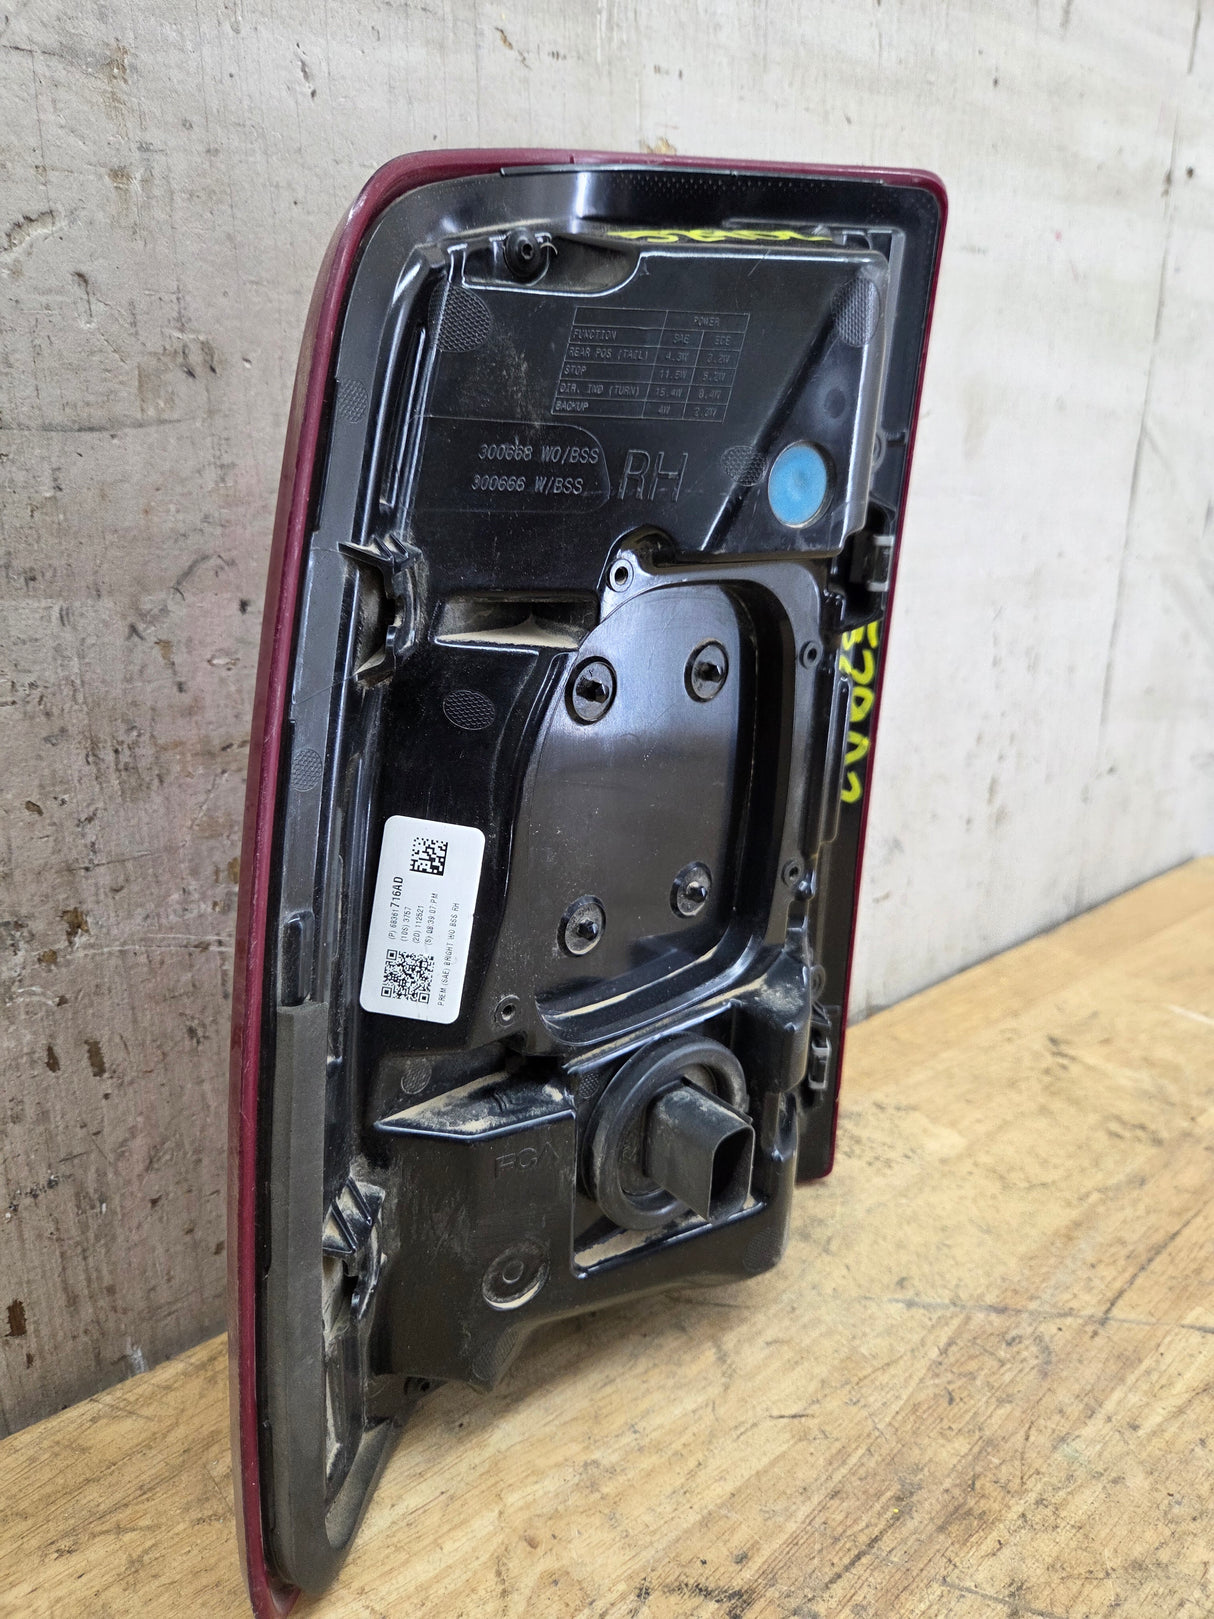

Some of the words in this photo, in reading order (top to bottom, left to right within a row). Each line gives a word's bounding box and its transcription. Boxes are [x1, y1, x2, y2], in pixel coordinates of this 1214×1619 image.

[693, 316, 721, 327] POWER
[572, 328, 617, 341] FUNCTION
[673, 333, 690, 344] SAE
[568, 346, 591, 358] REAR
[595, 348, 613, 359] POS
[617, 349, 648, 361] (TAIL)
[563, 364, 587, 376] STOP
[559, 382, 580, 394] DIR.
[587, 383, 604, 394] IND
[609, 384, 640, 396] (TURN)
[555, 400, 589, 412] BACKUP
[478, 443, 533, 463] 300668
[540, 446, 600, 465] WO/BSS
[618, 448, 689, 502] RH
[471, 475, 526, 492] 300666
[534, 477, 584, 495] W/BSS
[403, 906, 412, 923] 3757
[416, 905, 424, 928] 112521
[388, 930, 398, 940] (P)
[424, 935, 434, 946] (S)
[442, 942, 454, 966] BRIGHT
[439, 968, 450, 986] (SAE)
[437, 987, 447, 1006] PREM
